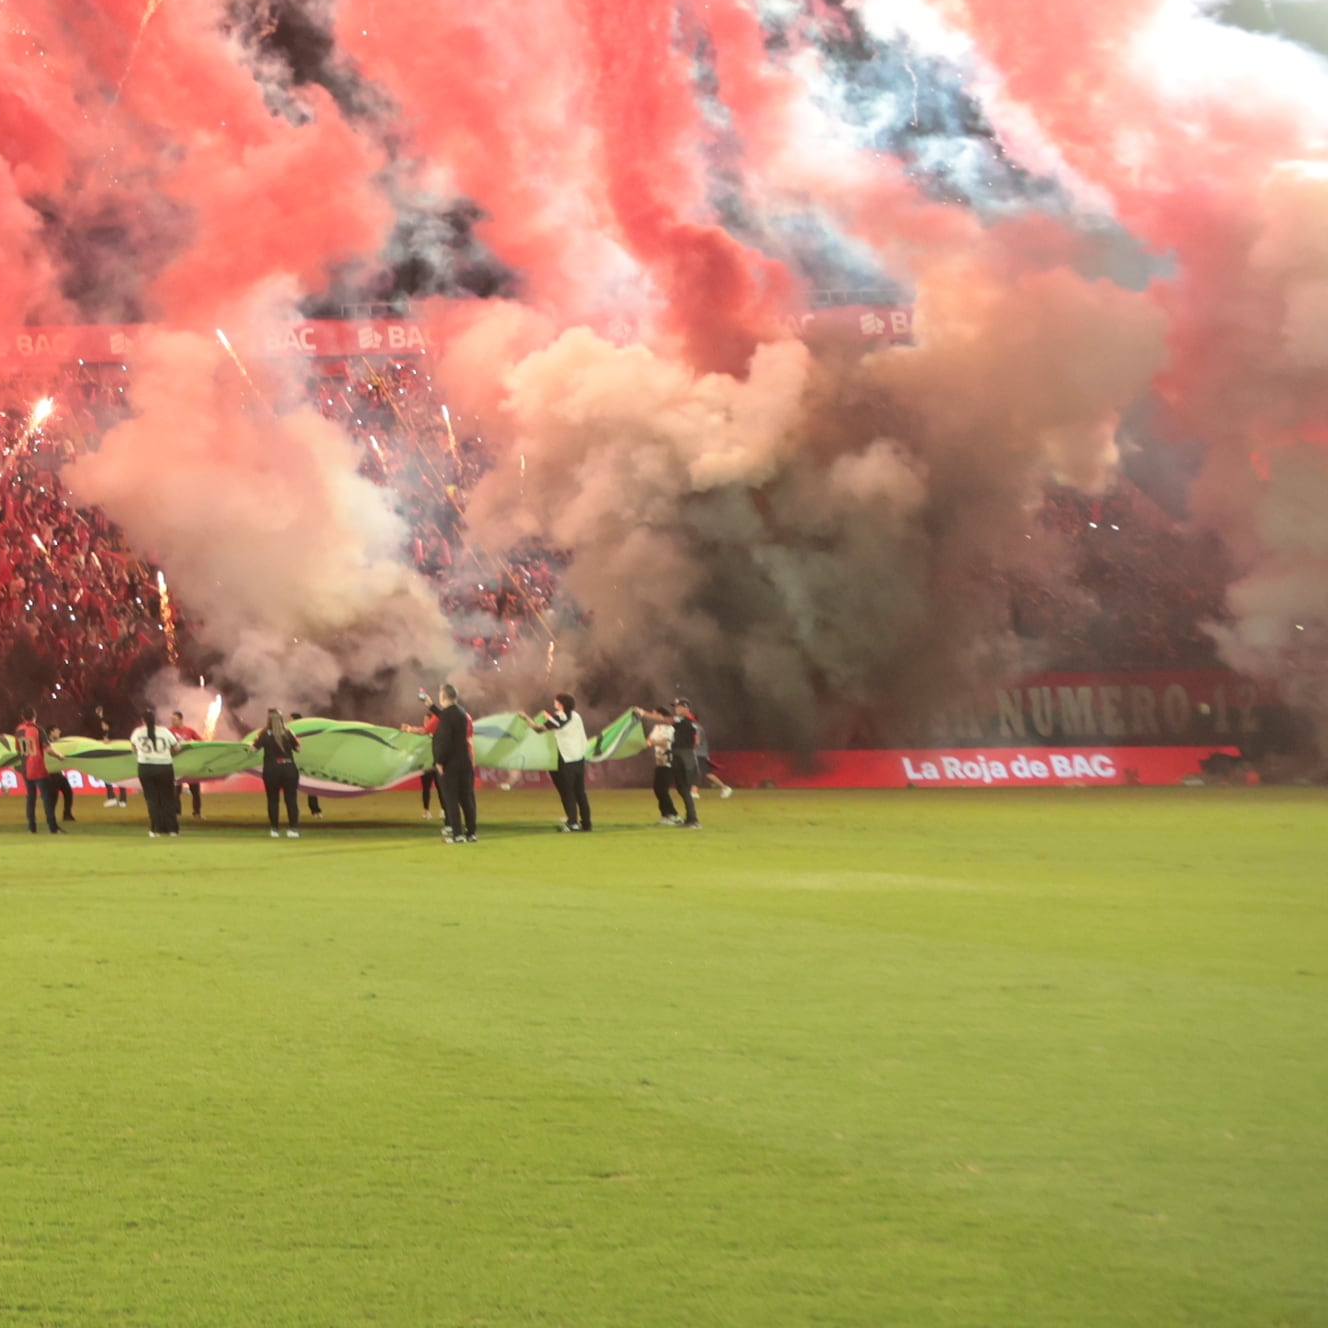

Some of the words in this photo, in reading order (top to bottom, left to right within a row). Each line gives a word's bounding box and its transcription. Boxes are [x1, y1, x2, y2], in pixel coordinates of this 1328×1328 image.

[901, 757, 940, 781] La
[941, 754, 1008, 784] Roja
[1010, 753, 1050, 779] de
[1049, 754, 1117, 779] BAC
